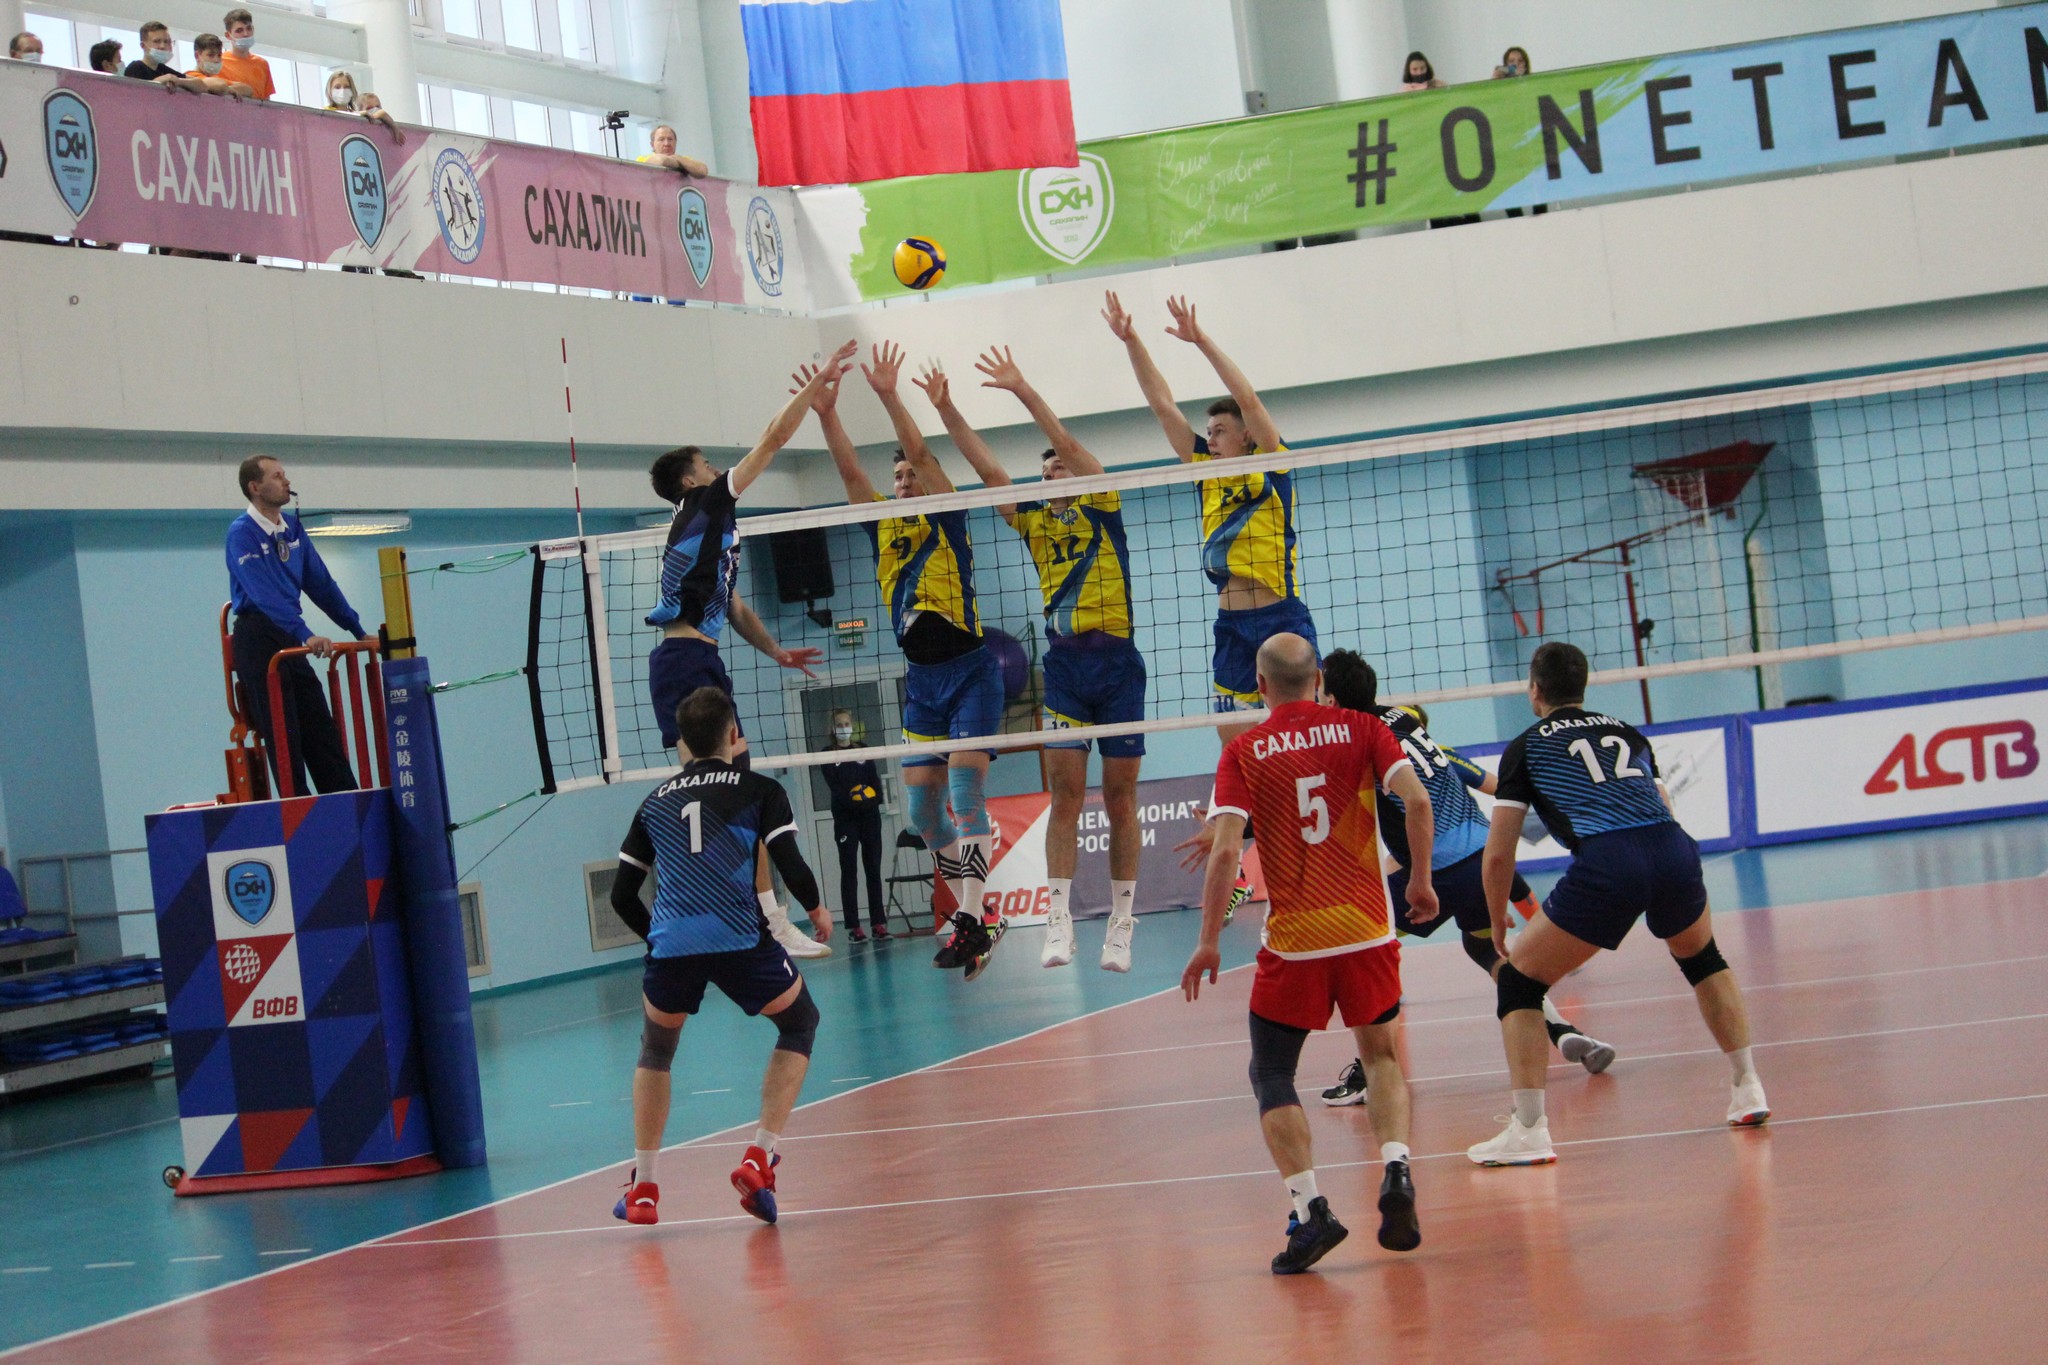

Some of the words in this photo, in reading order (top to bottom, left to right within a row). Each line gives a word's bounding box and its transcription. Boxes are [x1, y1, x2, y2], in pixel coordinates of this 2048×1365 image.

[131, 129, 297, 217] САХАЛИН
[524, 185, 647, 258] САХАЛИН
[891, 536, 912, 560] 9
[1050, 534, 1086, 566] 12
[838, 620, 865, 629] ВЫХОД
[1253, 723, 1352, 760] САХАЛИН
[1538, 715, 1626, 737] САХАЛИН
[1400, 726, 1449, 779] 15
[1567, 735, 1645, 784] 12
[657, 771, 741, 798] САХАЛИН
[1076, 800, 1201, 831] ЕМИОНАТ
[1295, 772, 1330, 845] 5
[681, 800, 702, 854] 1
[783, 959, 793, 977] 1
[252, 995, 298, 1019] ВФВ
